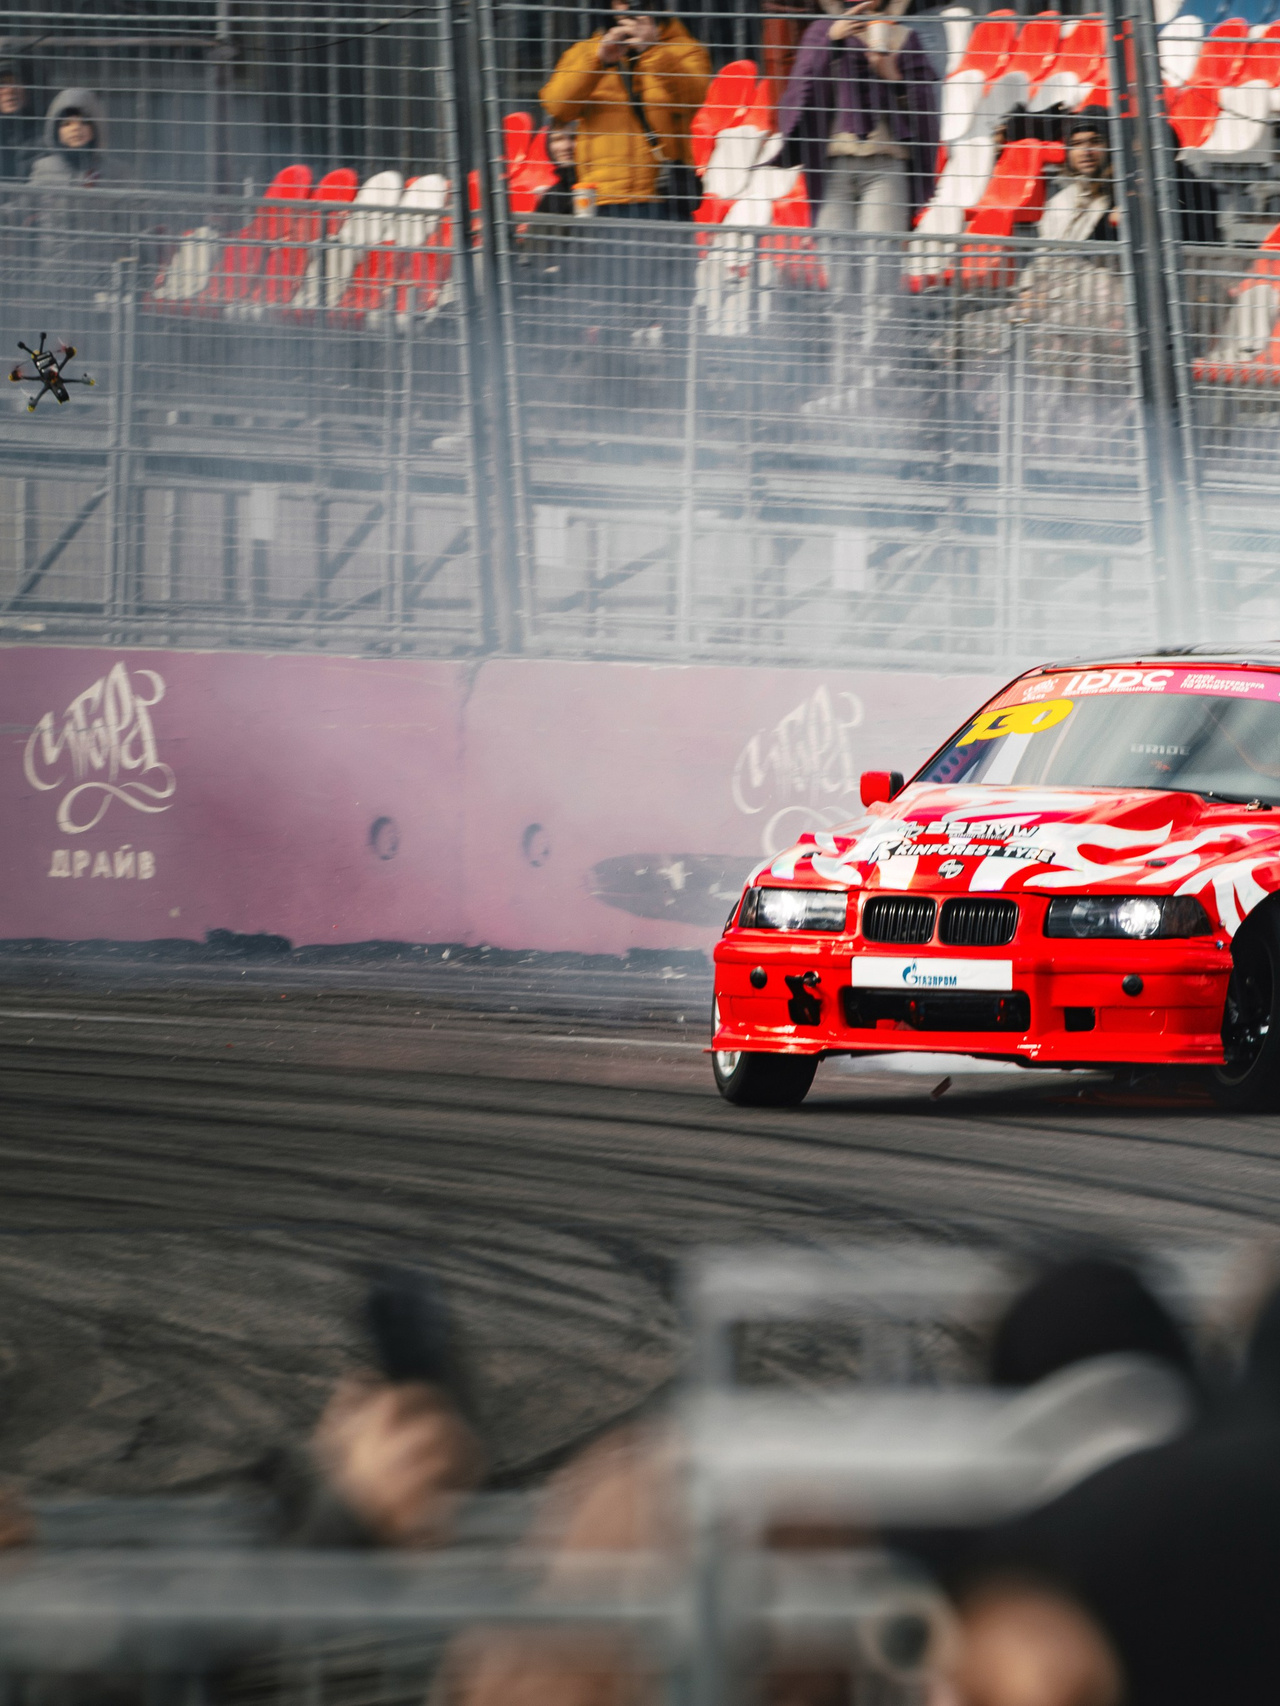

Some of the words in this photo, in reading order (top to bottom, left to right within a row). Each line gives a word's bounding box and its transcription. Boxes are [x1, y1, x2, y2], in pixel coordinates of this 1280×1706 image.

[1065, 669, 1174, 691] IDDC
[925, 821, 1041, 838] SSBMW
[47, 844, 157, 880] ДРАЙВ
[893, 843, 999, 858] KINFOREST
[1003, 846, 1056, 864] TYRE
